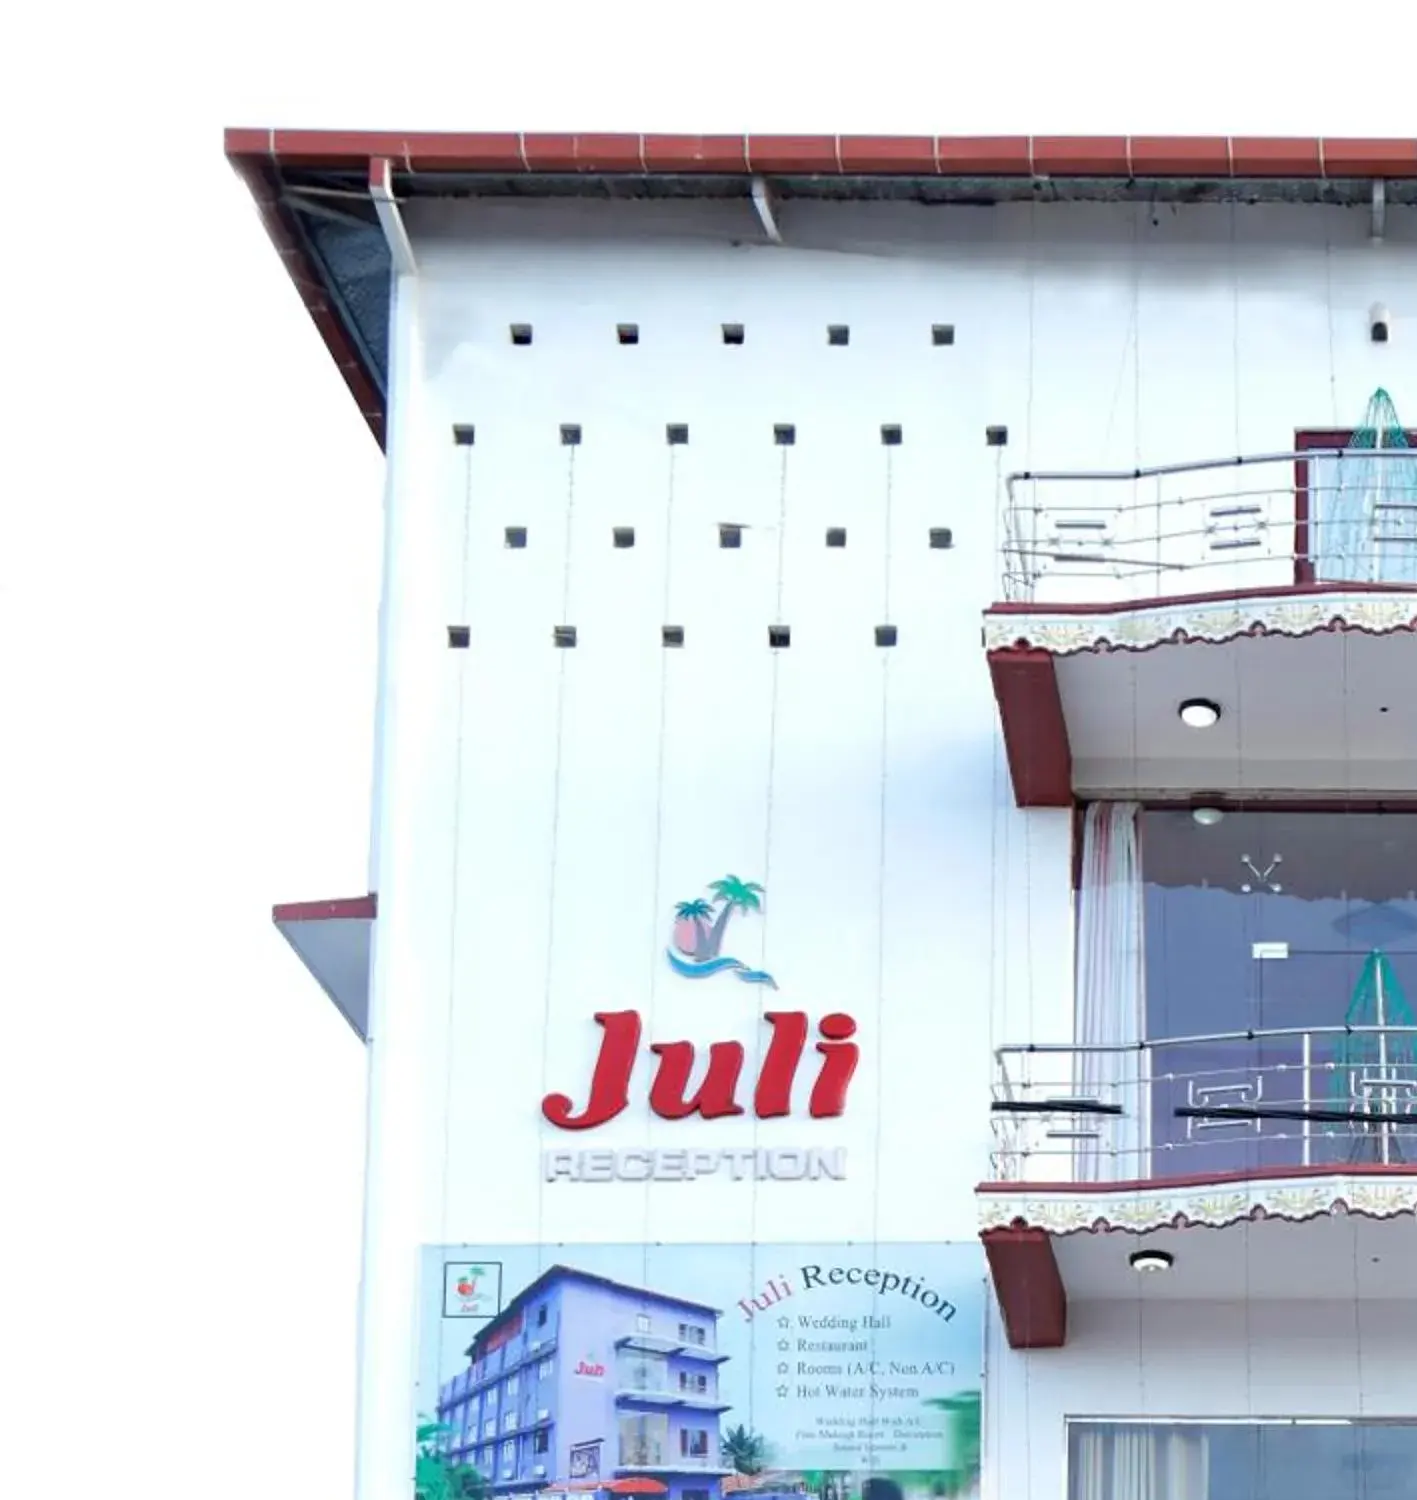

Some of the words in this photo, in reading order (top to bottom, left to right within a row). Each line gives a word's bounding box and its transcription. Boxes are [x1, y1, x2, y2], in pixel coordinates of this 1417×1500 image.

[541, 1009, 860, 1132] Juli
[544, 1146, 847, 1183] RECEPTION
[738, 1273, 793, 1323] Juli
[800, 1264, 957, 1323] Reception
[798, 1316, 858, 1331] Wedding
[862, 1316, 891, 1329] Hall
[797, 1338, 868, 1351] Restaurant
[797, 1362, 842, 1375] Rooms
[890, 1362, 917, 1375] Non
[797, 1385, 820, 1398] Hot
[825, 1385, 865, 1398] Water
[870, 1385, 919, 1400] System
